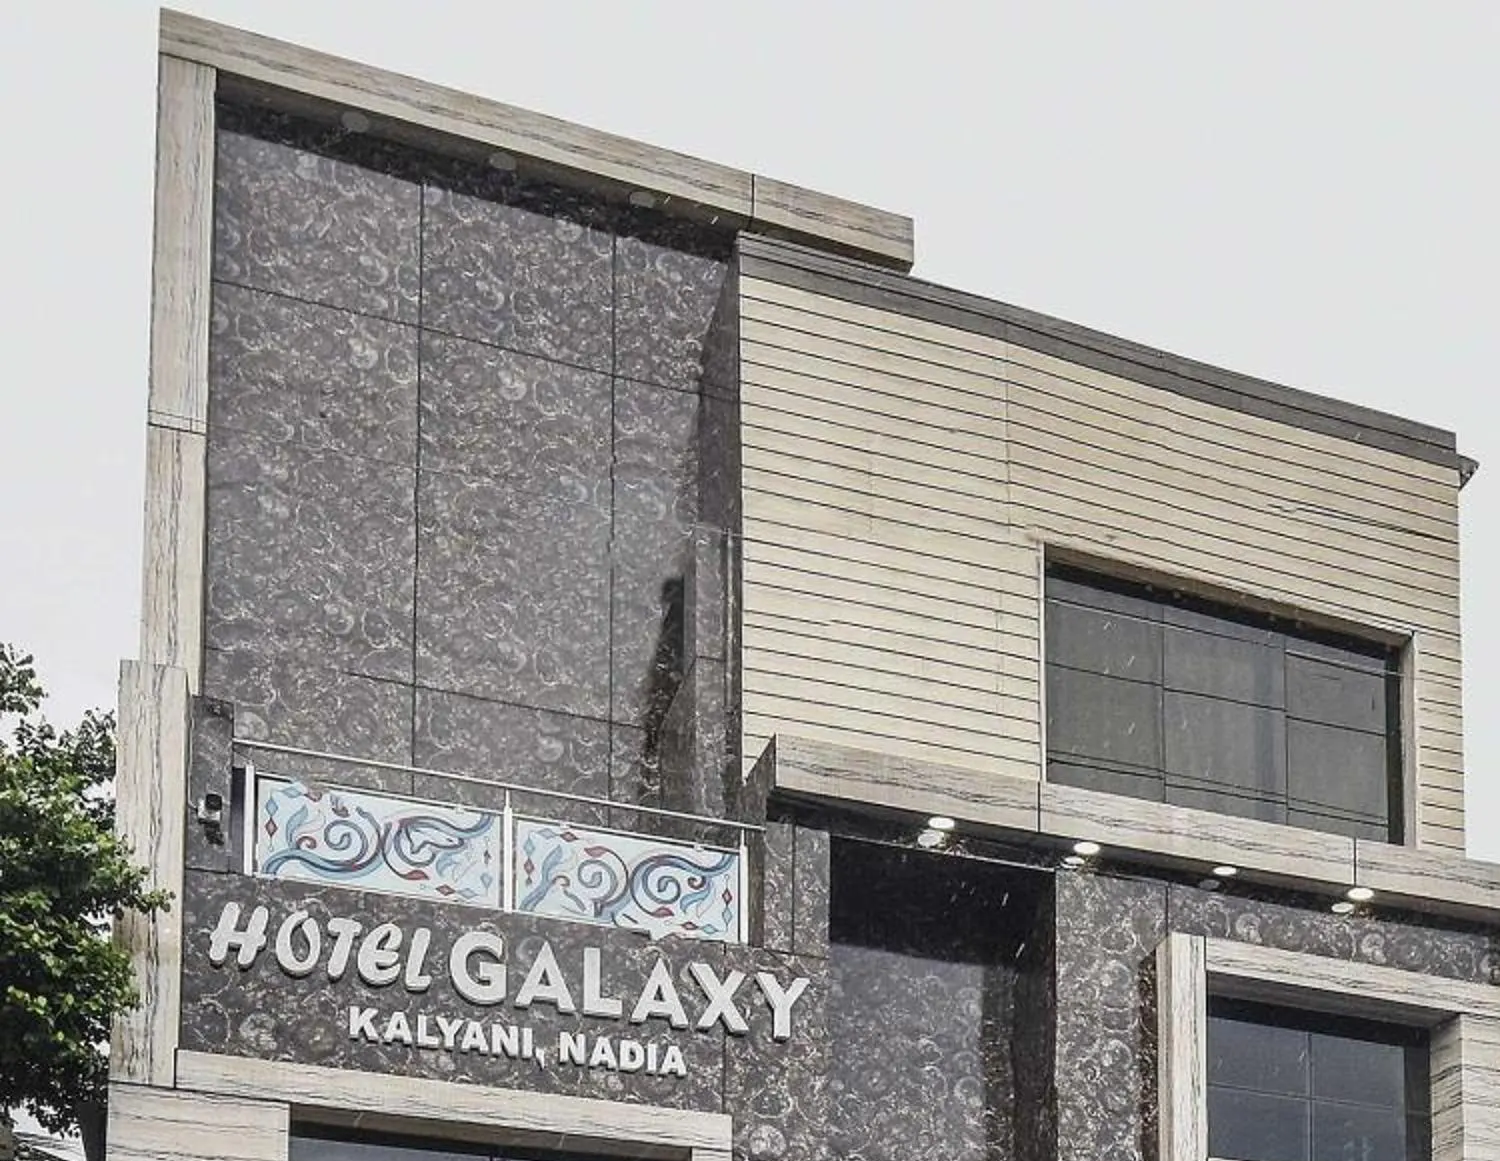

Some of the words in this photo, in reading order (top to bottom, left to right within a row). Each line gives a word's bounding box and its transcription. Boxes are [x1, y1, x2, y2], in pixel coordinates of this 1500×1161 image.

[448, 931, 810, 1041] GALAXY
[349, 1005, 545, 1070] KALYANI,
[558, 1031, 688, 1077] NADIA
